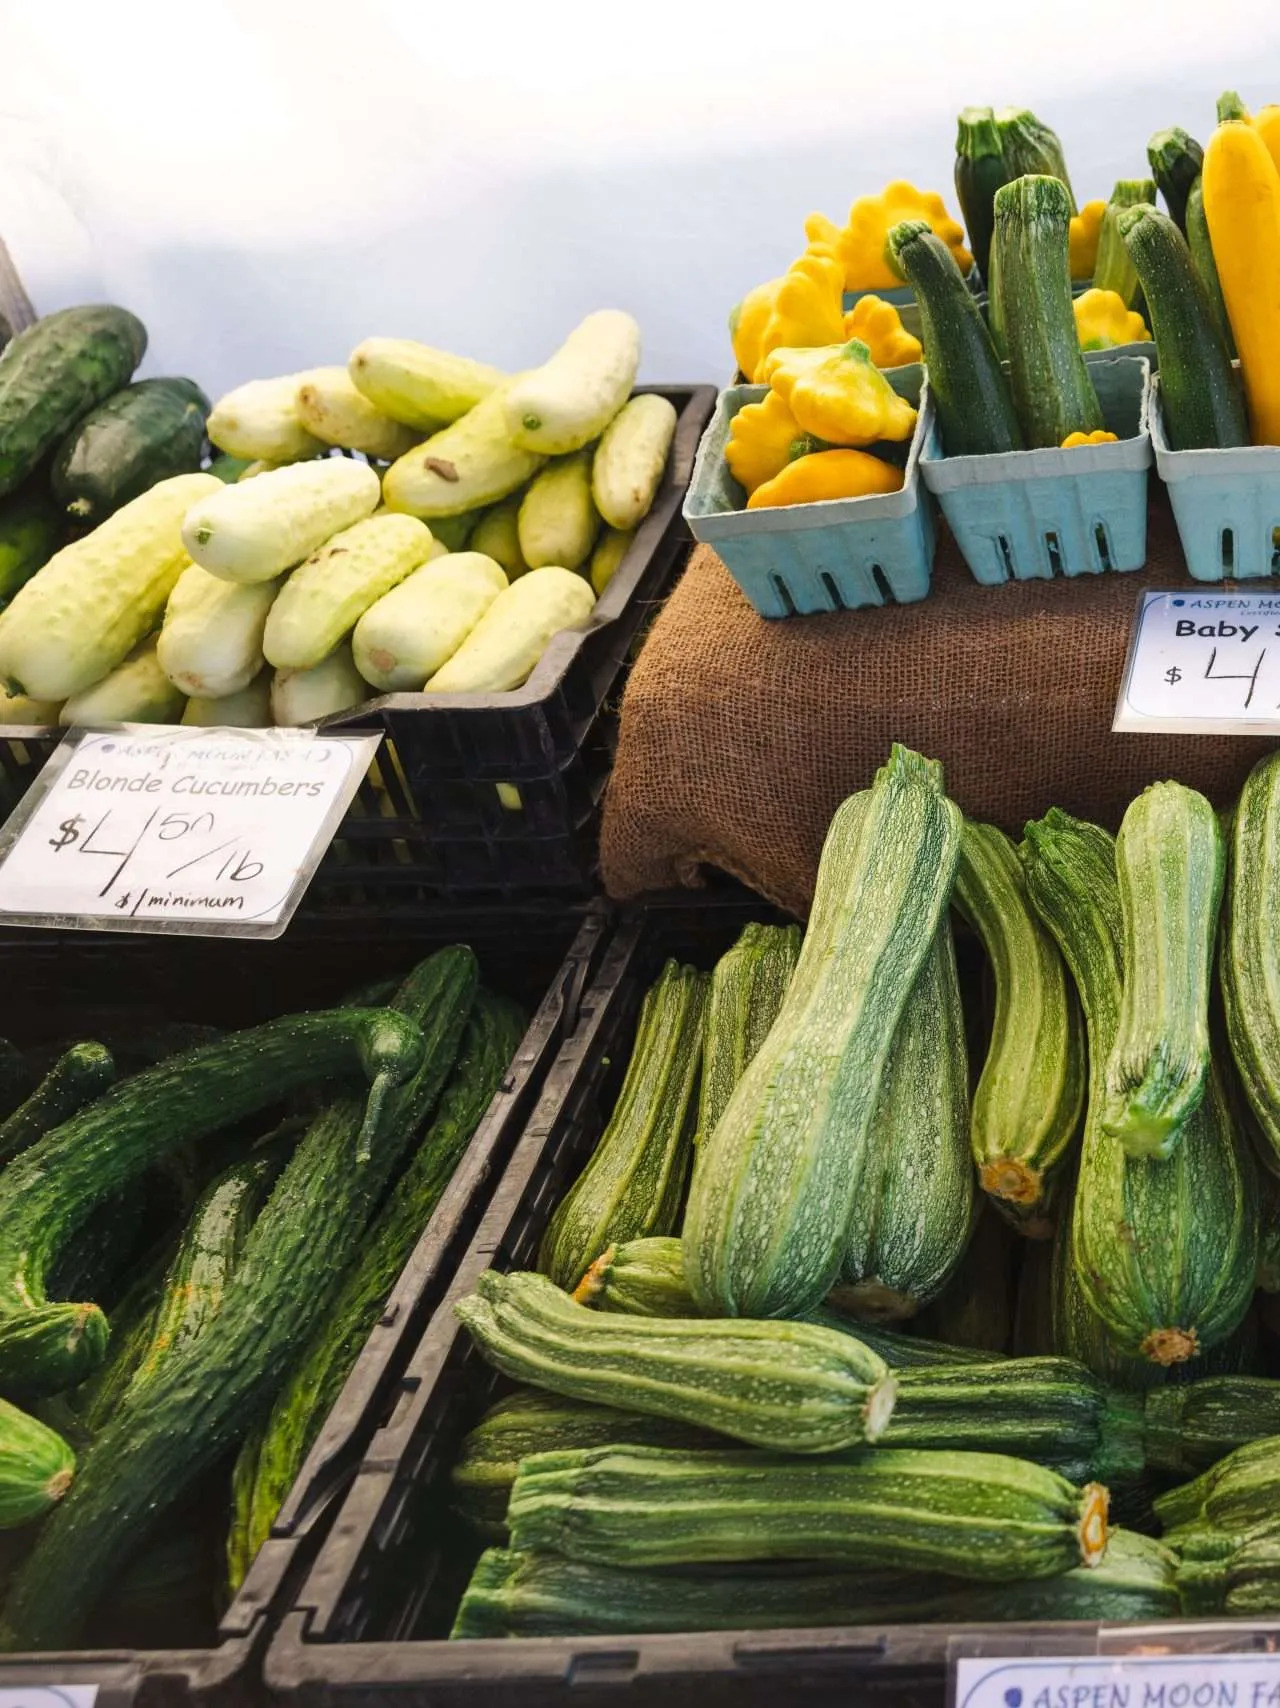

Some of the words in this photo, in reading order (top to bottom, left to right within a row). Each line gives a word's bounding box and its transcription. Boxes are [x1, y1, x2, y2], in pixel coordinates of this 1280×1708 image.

[1190, 600, 1251, 610] ASPEN
[1175, 619, 1259, 643] Baby
[67, 769, 162, 793] Blonde
[171, 775, 325, 797] Cucumbers
[148, 894, 244, 910] minimum
[1032, 1684, 1131, 1708] ASPEN
[1143, 1681, 1239, 1708] MOON
